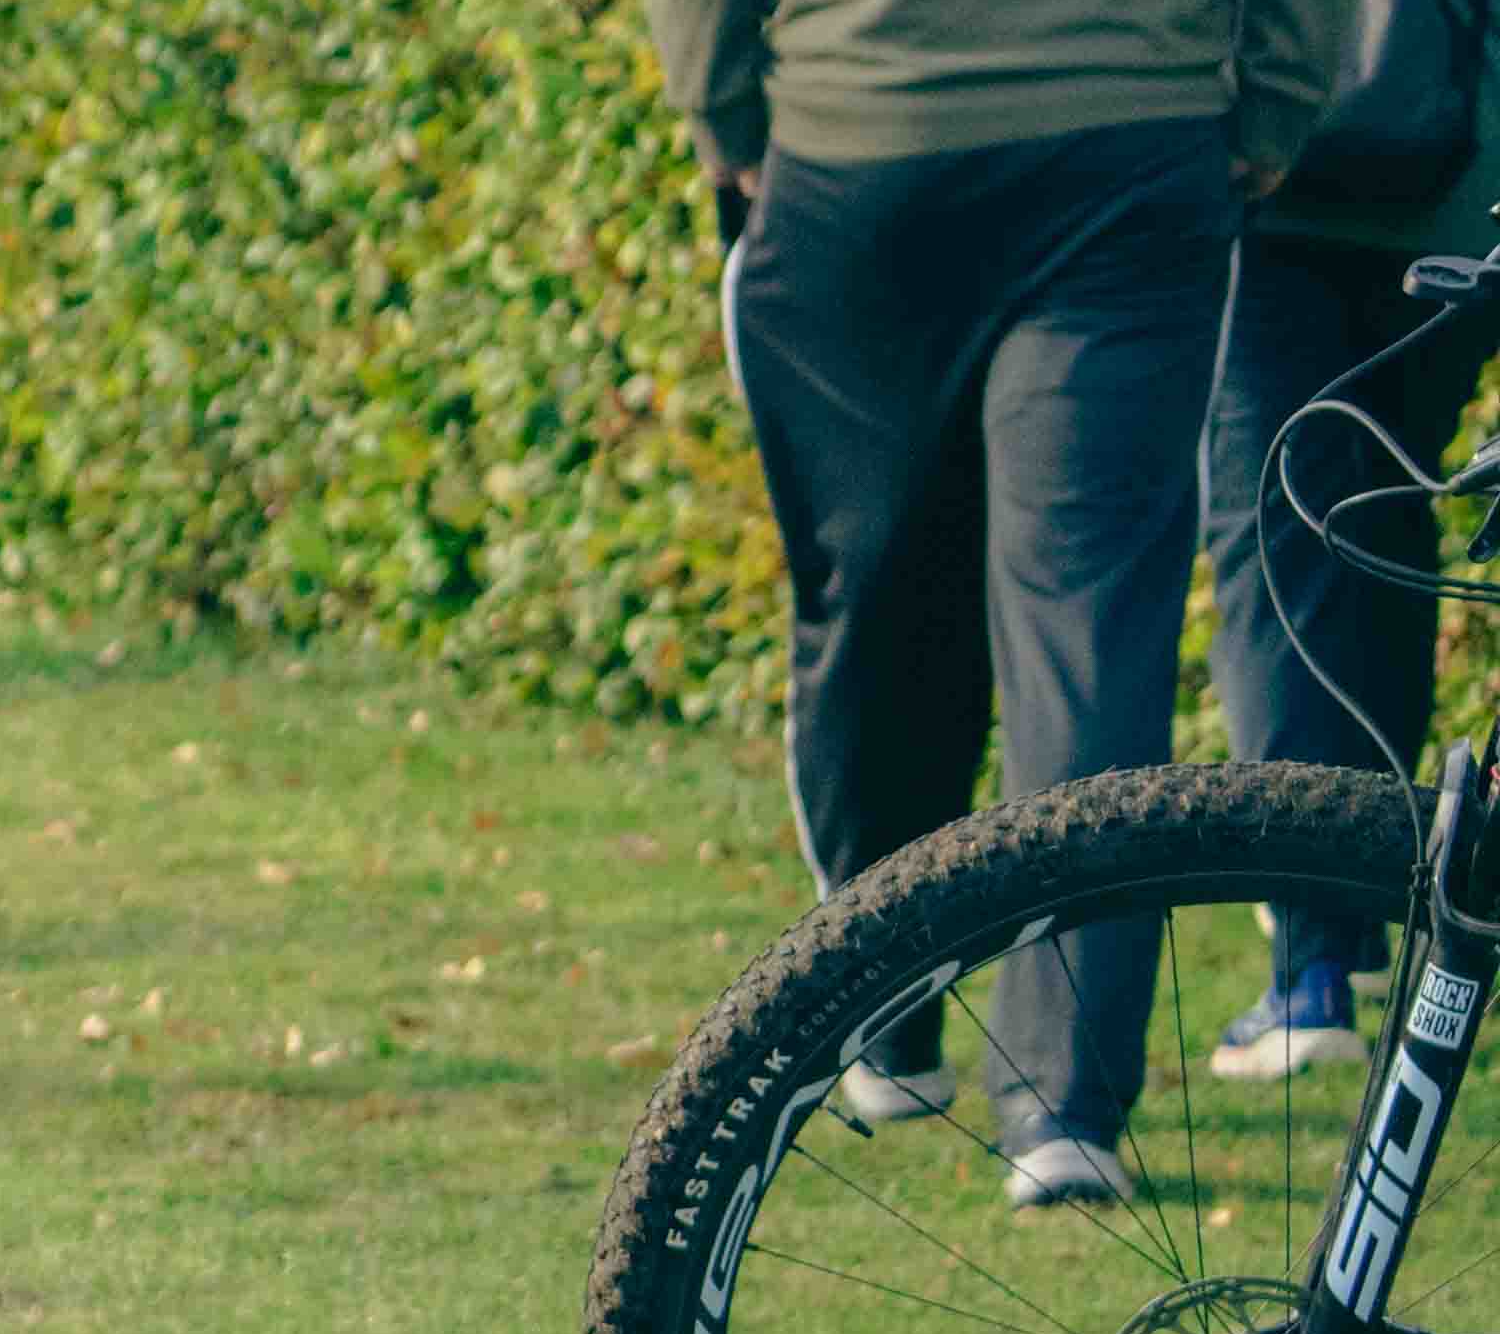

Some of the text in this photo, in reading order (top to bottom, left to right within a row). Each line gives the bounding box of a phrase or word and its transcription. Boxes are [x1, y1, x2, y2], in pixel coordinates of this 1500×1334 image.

[1413, 1002, 1460, 1041] SHOX
[1423, 970, 1471, 1012] ROCK
[666, 1152, 720, 1251] FAST
[712, 1048, 794, 1141] TRAK
[1326, 1042, 1443, 1324] SID
